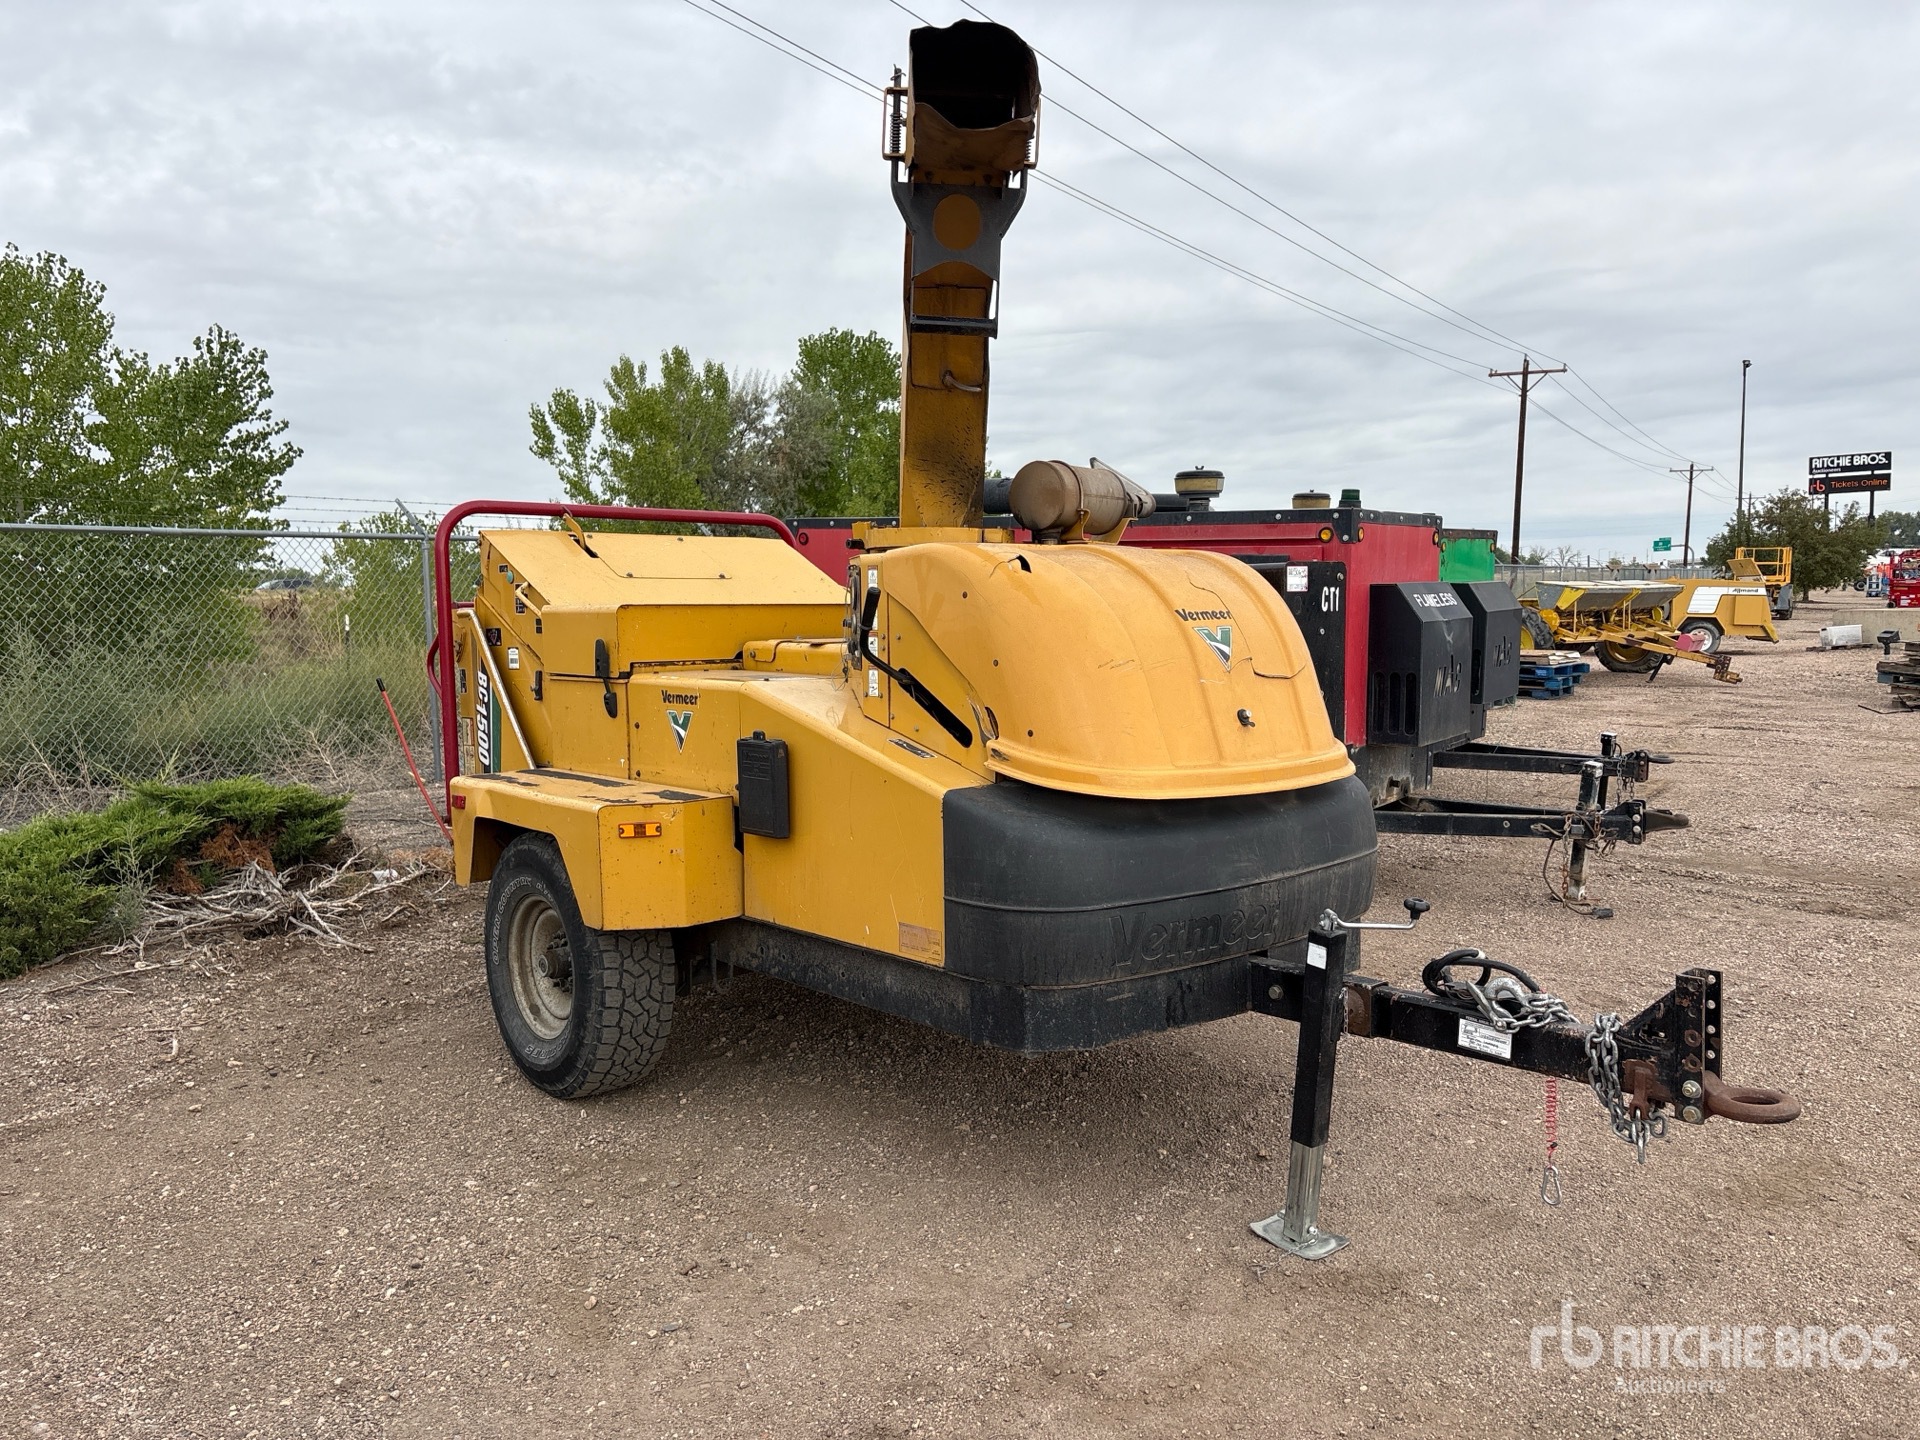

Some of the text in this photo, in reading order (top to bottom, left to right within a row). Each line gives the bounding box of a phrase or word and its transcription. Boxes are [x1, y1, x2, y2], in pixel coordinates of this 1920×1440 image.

[1812, 453, 1888, 469] RITCHIE BROS.
[1321, 586, 1340, 612] CT1
[1413, 592, 1457, 608] FLAMELESS
[1174, 608, 1232, 621] Vermeer
[661, 689, 699, 706] Vermeer
[492, 913, 502, 966] OPEN
[1109, 902, 1280, 967] Vermeer
